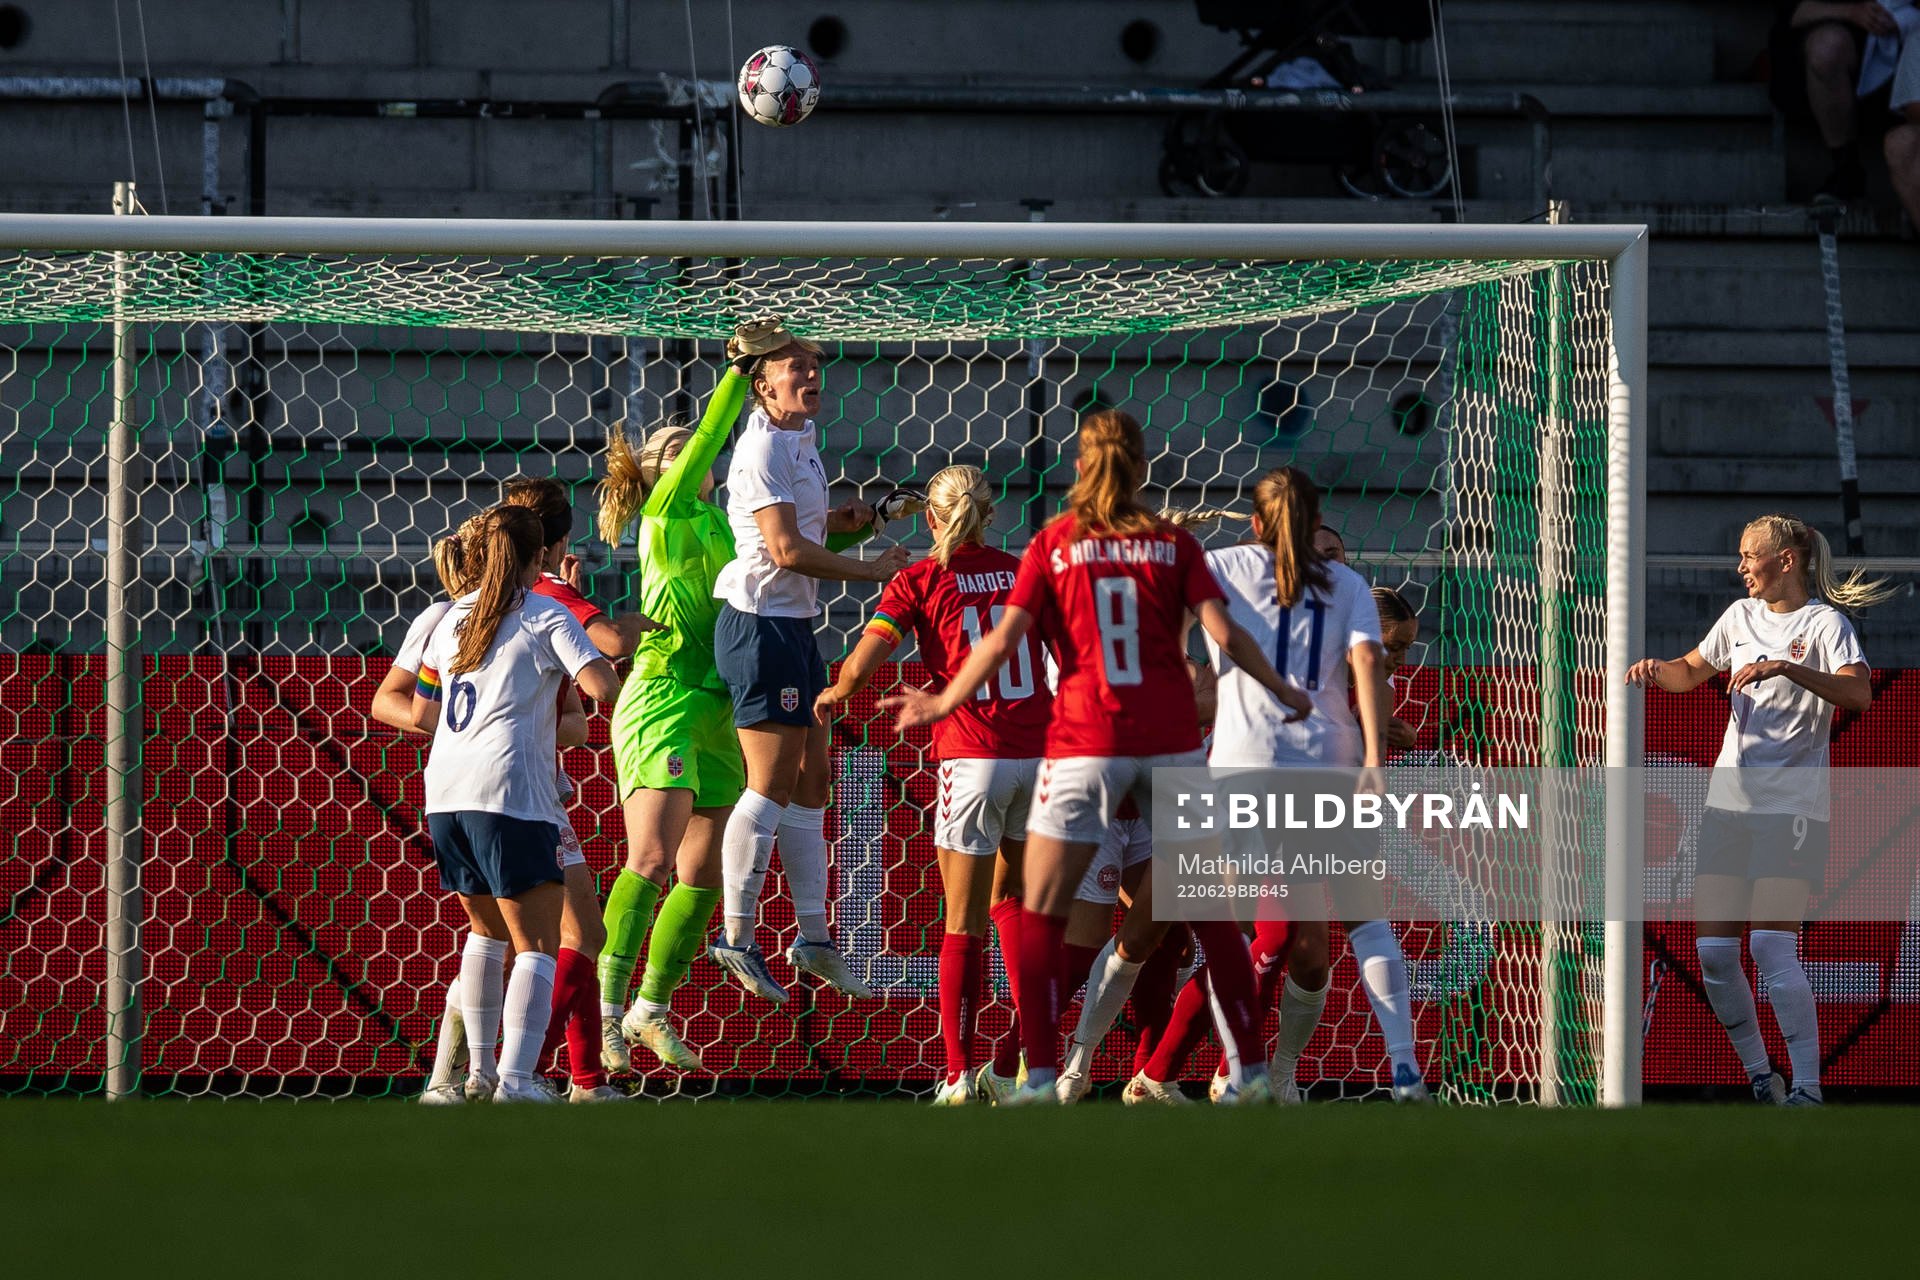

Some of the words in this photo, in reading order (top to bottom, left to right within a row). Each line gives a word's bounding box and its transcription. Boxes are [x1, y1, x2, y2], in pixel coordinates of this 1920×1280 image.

[1069, 538, 1176, 567] HOLMGAARD
[956, 570, 1016, 594] HARDER
[1094, 576, 1143, 686] 8
[962, 604, 1034, 701] 10
[1791, 815, 1808, 851] 9
